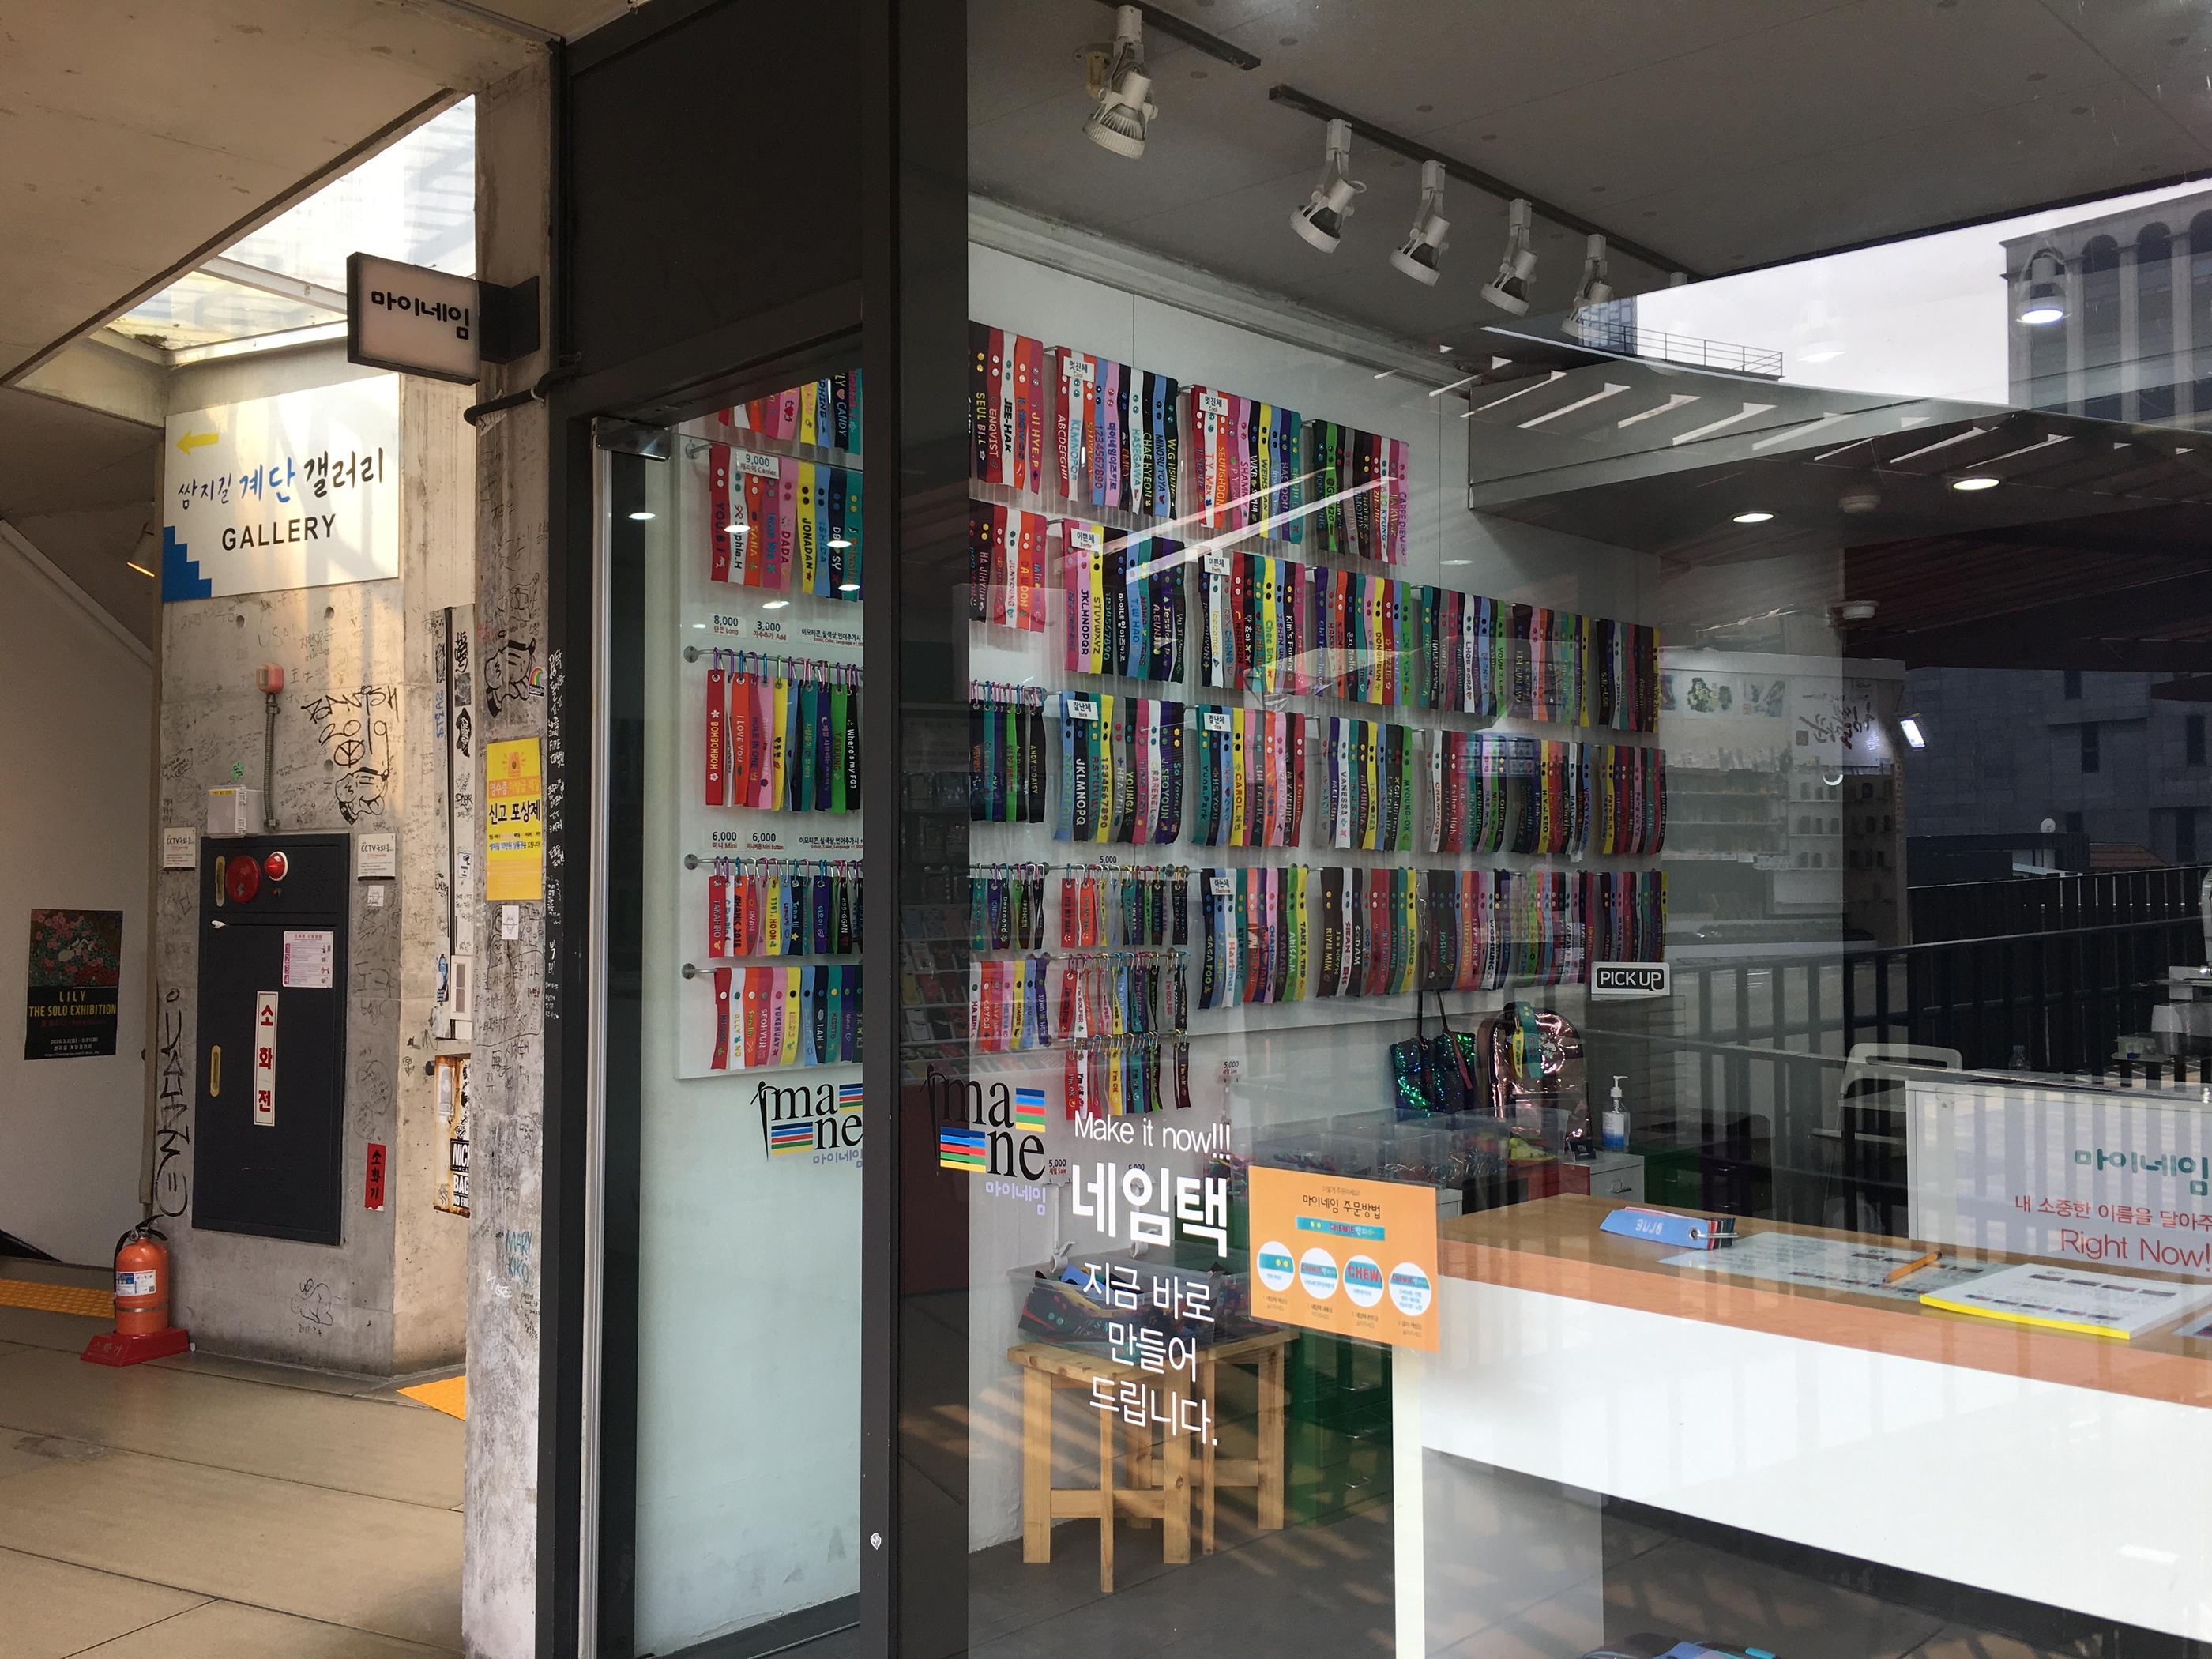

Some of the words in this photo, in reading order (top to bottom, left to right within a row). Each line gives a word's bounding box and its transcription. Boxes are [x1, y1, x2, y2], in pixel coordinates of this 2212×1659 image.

[371, 289, 469, 340] 마이네임
[1069, 360, 1087, 373] 멋진체
[976, 393, 986, 419] SEUL
[1205, 396, 1221, 407] 멋진체
[837, 402, 847, 437] CANDY
[1032, 412, 1039, 427] JI
[746, 454, 770, 467] 9,000
[1031, 429, 1040, 468] HYE.P
[1095, 425, 1104, 488] 1234567890
[1133, 429, 1142, 486] HASEGAWA
[1143, 433, 1152, 461] CHAE
[1168, 439, 1176, 460] W.G
[178, 474, 232, 509] 쌈지길
[239, 457, 295, 503] 계단
[304, 447, 385, 498] 갤러리
[758, 467, 777, 476] Carrier
[1217, 446, 1225, 506] SEUNGHOON
[221, 514, 336, 551] GALLERY
[803, 518, 813, 569] JONADAN
[980, 552, 988, 565] HA
[714, 615, 738, 626] 8,000
[758, 621, 781, 631] 3,000
[318, 720, 389, 764] 2019
[847, 729, 856, 760] Where's
[849, 763, 856, 773] my
[1076, 759, 1087, 826] JKLMNOPQ
[1125, 772, 1134, 814] YOUNGA
[1161, 758, 1169, 819] J.SEOYOUN
[489, 803, 507, 825] 신고
[511, 799, 540, 822] 포상제
[713, 832, 737, 841] 6,000
[753, 833, 776, 842] 6,000
[60, 991, 86, 1003] LILY
[1601, 972, 1636, 986] PICK
[1639, 972, 1661, 991] UP
[29, 1006, 45, 1017] THE
[48, 1006, 68, 1017] SOLO
[71, 1004, 116, 1015] EXHIBITION
[258, 1005, 274, 1112] 소화전
[772, 1083, 838, 1120] ma
[942, 1081, 1014, 1128] ma
[1074, 1110, 1134, 1146] Make
[1144, 1118, 1153, 1147] it
[1163, 1123, 1231, 1161] now!!!
[453, 1143, 469, 1166] NIC
[988, 1131, 1045, 1180] ne
[2075, 1149, 2209, 1196] 마이네임
[986, 1181, 1046, 1215] 마이네임
[1072, 1162, 1228, 1258] 네임택
[1303, 1194, 1339, 1214] 마이네임
[1344, 1200, 1381, 1220] 주문방법
[2014, 1194, 2032, 1214] 내
[2038, 1197, 2091, 1219] 소중한
[2099, 1205, 2152, 1226] 이름을
[1330, 1223, 1354, 1234] CHEWIE
[2061, 1229, 2128, 1260] Right
[2140, 1238, 2211, 1272] Now!
[1083, 1262, 1142, 1311] 지금
[1153, 1275, 1215, 1323] 바로
[1108, 1322, 1197, 1382] 만들어
[1089, 1375, 1217, 1446] 드립니다.
